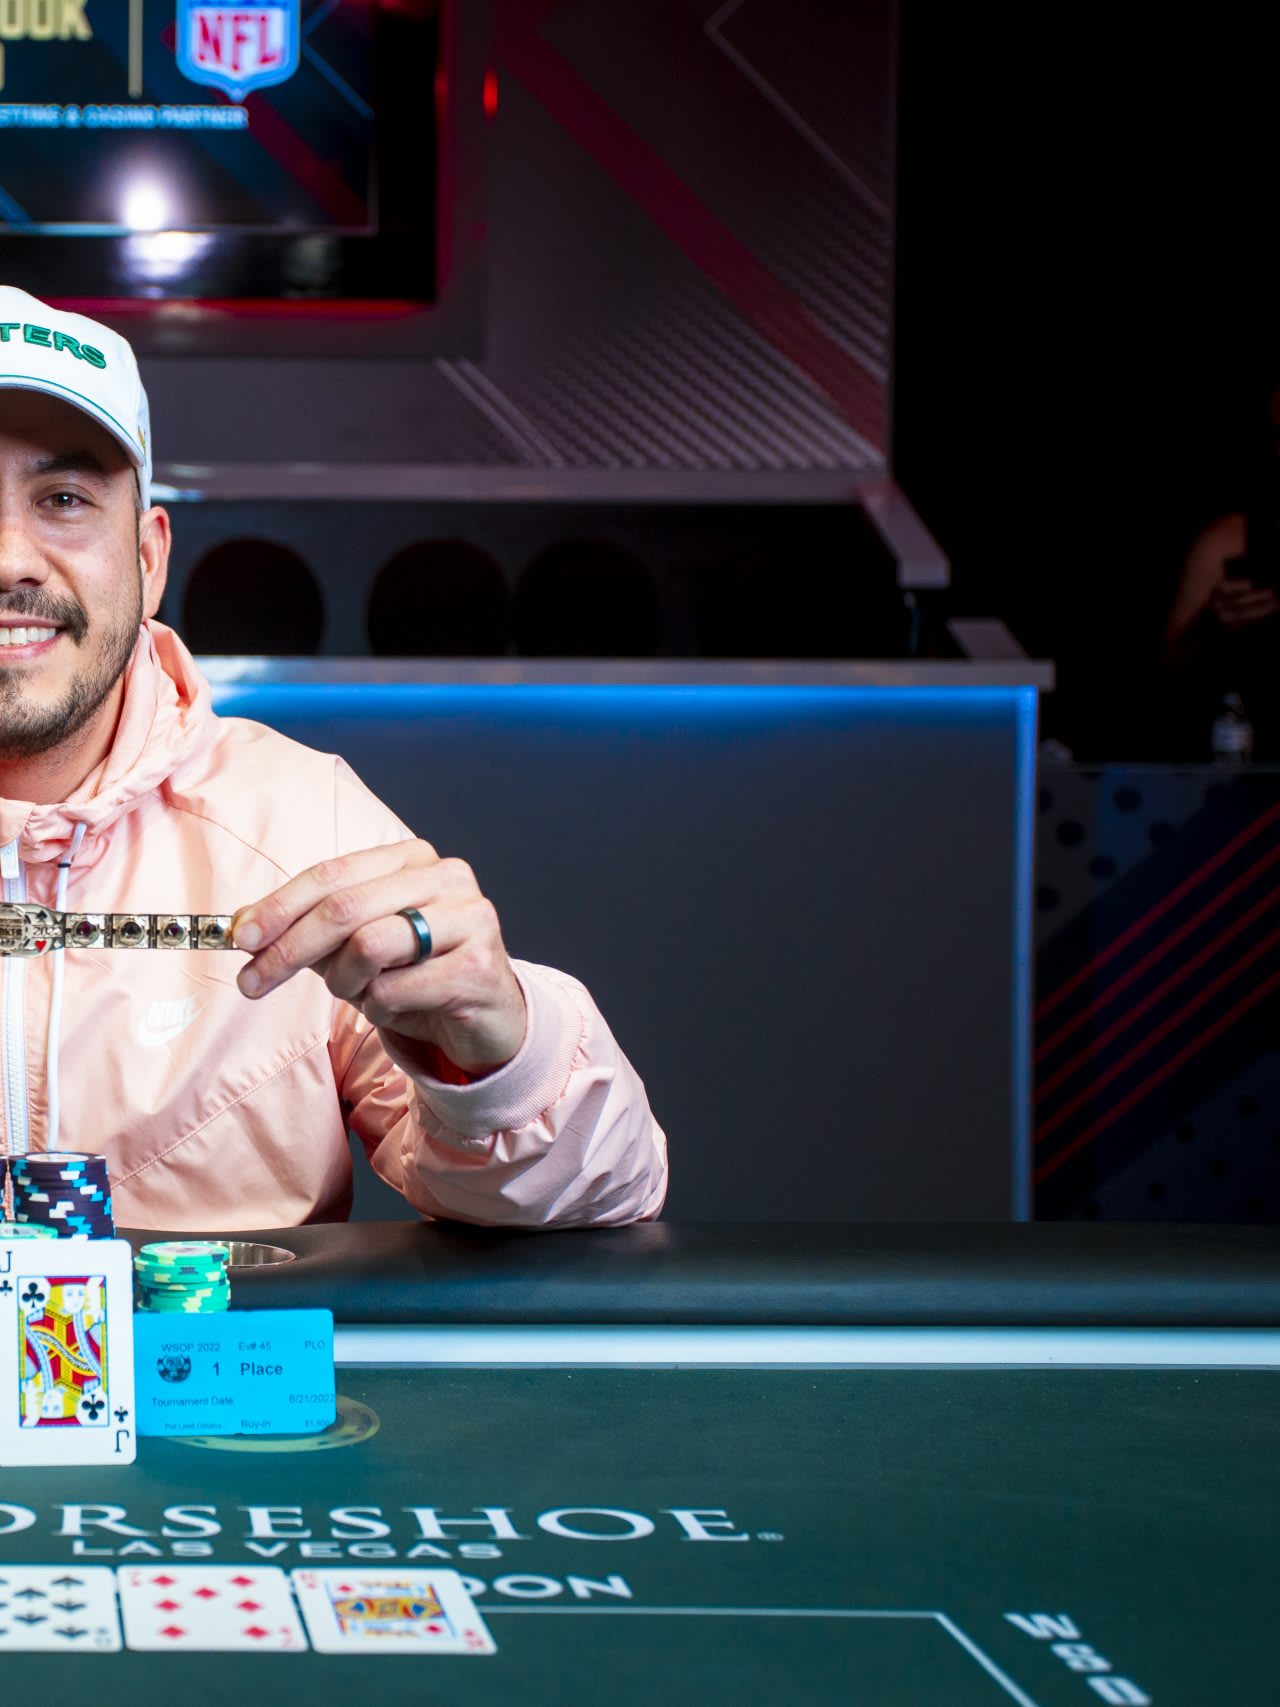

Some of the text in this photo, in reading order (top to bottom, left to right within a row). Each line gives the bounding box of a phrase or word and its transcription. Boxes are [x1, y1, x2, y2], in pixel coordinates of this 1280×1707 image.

[196, 14, 282, 71] NFL
[162, 1343, 221, 1353] WSOP 2022
[305, 1340, 326, 1350] PLO
[212, 1362, 220, 1376] 1
[240, 1362, 283, 1376] Place
[152, 1396, 234, 1407] Tournament Date
[72, 1540, 504, 1559] LAS VEGAS
